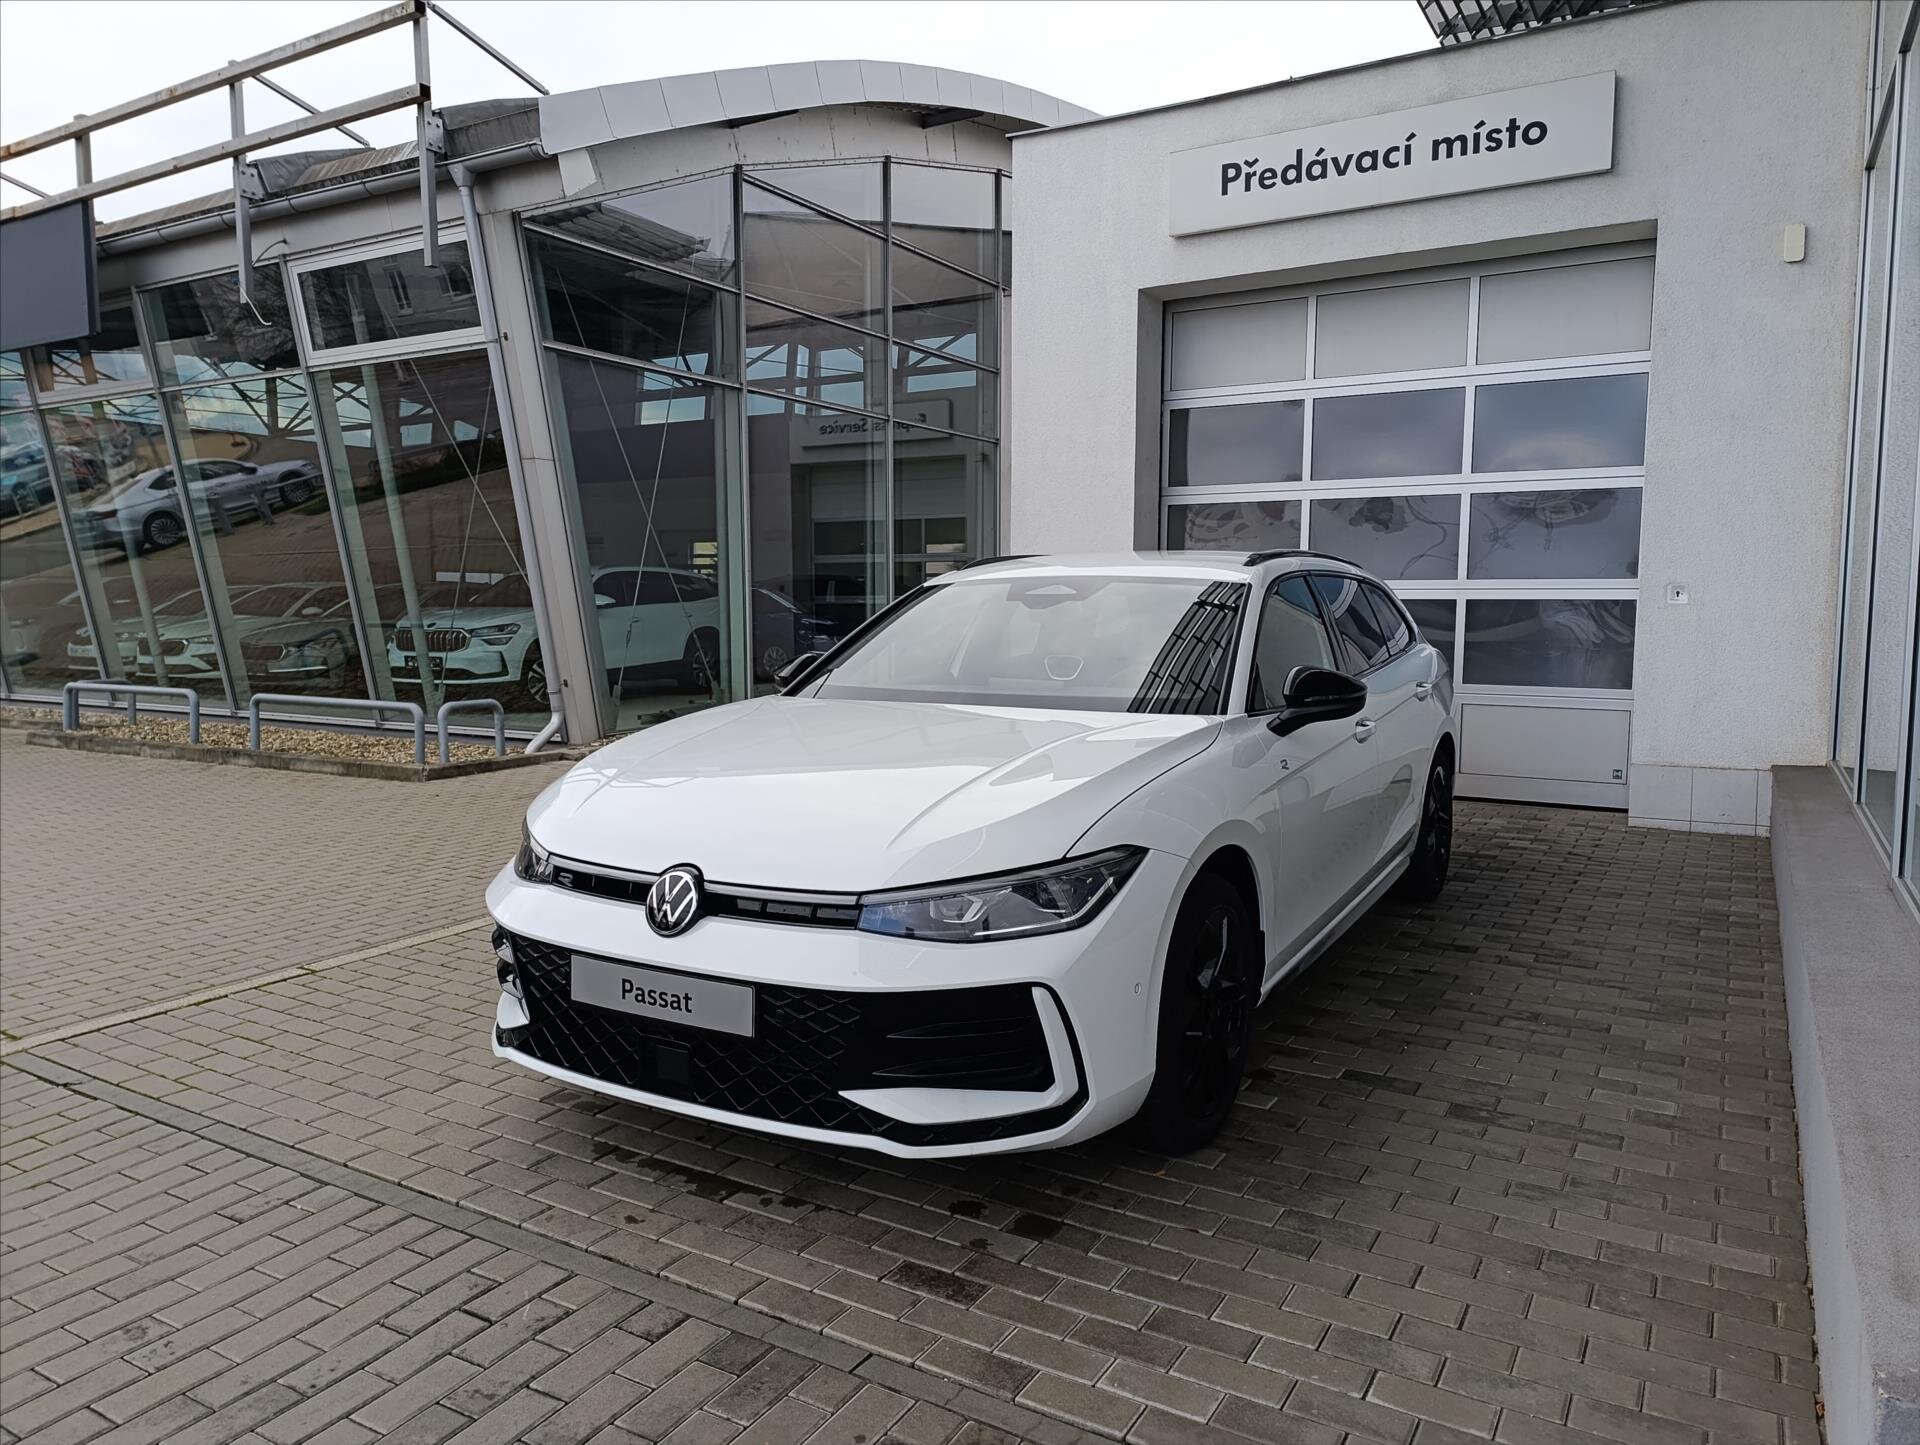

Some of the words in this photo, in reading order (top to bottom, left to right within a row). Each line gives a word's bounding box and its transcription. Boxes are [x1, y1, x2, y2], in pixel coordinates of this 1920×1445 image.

[1220, 131, 1417, 196] Předávací
[1431, 118, 1549, 161] místo
[621, 978, 693, 1014] Passat
